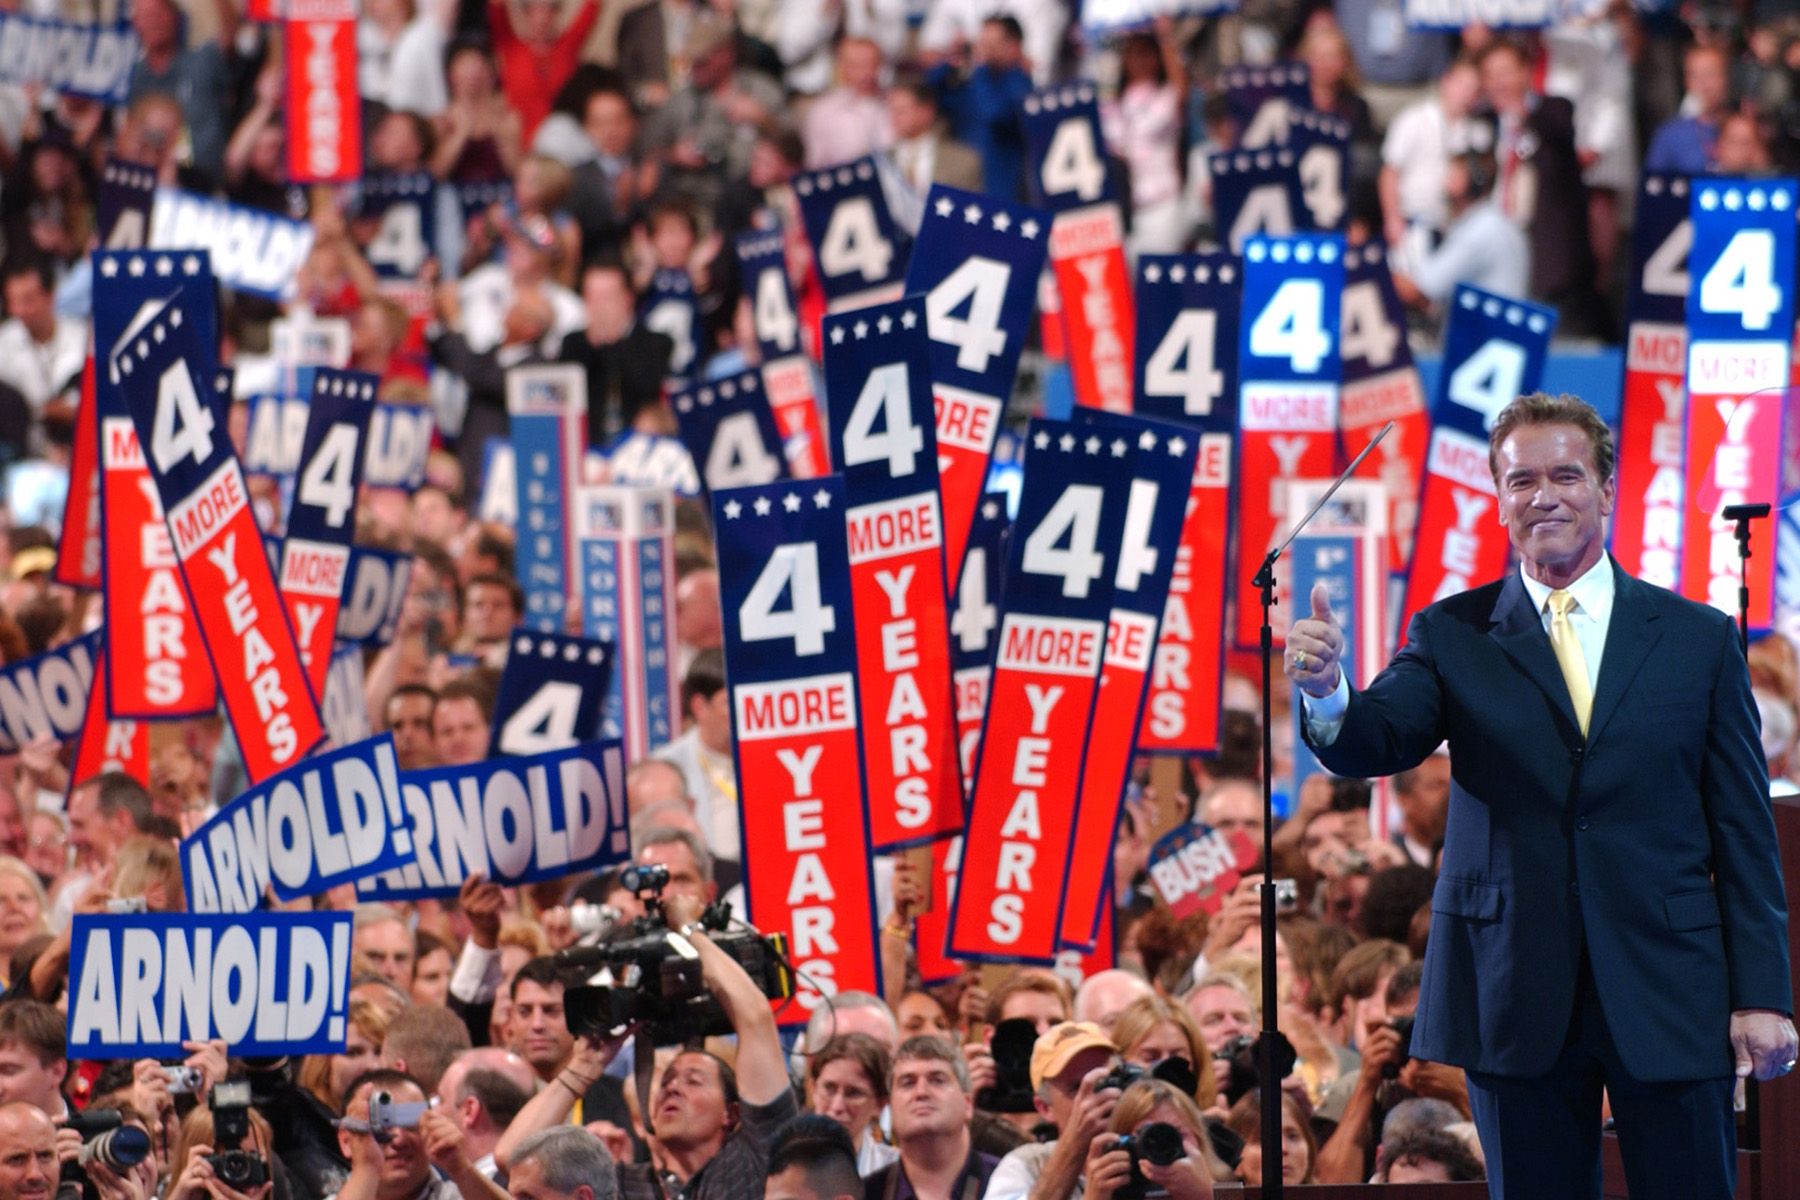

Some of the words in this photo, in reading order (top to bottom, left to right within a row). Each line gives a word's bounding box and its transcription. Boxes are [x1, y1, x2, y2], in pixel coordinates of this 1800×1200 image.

[1040, 117, 1104, 200] 4
[366, 203, 426, 274] 4
[820, 199, 894, 281] 4
[1701, 228, 1783, 331] 4
[757, 267, 797, 351] 4
[926, 256, 1012, 374] 4
[1249, 278, 1333, 374] 4
[1340, 280, 1400, 369] 4
[1634, 335, 1682, 367] MO
[1145, 308, 1226, 414] 4
[152, 359, 215, 475] 4
[703, 411, 780, 490] 4
[843, 363, 923, 477] 4
[1437, 445, 1492, 485] MOR
[175, 479, 240, 543] MORE
[301, 422, 359, 528] 4
[286, 552, 343, 589] MORE
[849, 501, 933, 561] MORE
[1022, 483, 1104, 598] 4
[1433, 488, 1489, 603] YEA
[738, 541, 836, 657] 4
[1006, 625, 1096, 669] MORE
[207, 533, 298, 764] YEARS
[874, 564, 932, 828] YEARS
[501, 681, 582, 756] 4
[743, 686, 846, 732] MORE
[188, 742, 413, 914] ARNOLD!
[985, 683, 1065, 946] YEARS
[775, 745, 841, 1010] YEARS
[1150, 828, 1237, 905] BUSH
[70, 922, 351, 1046] ARNOLD!
